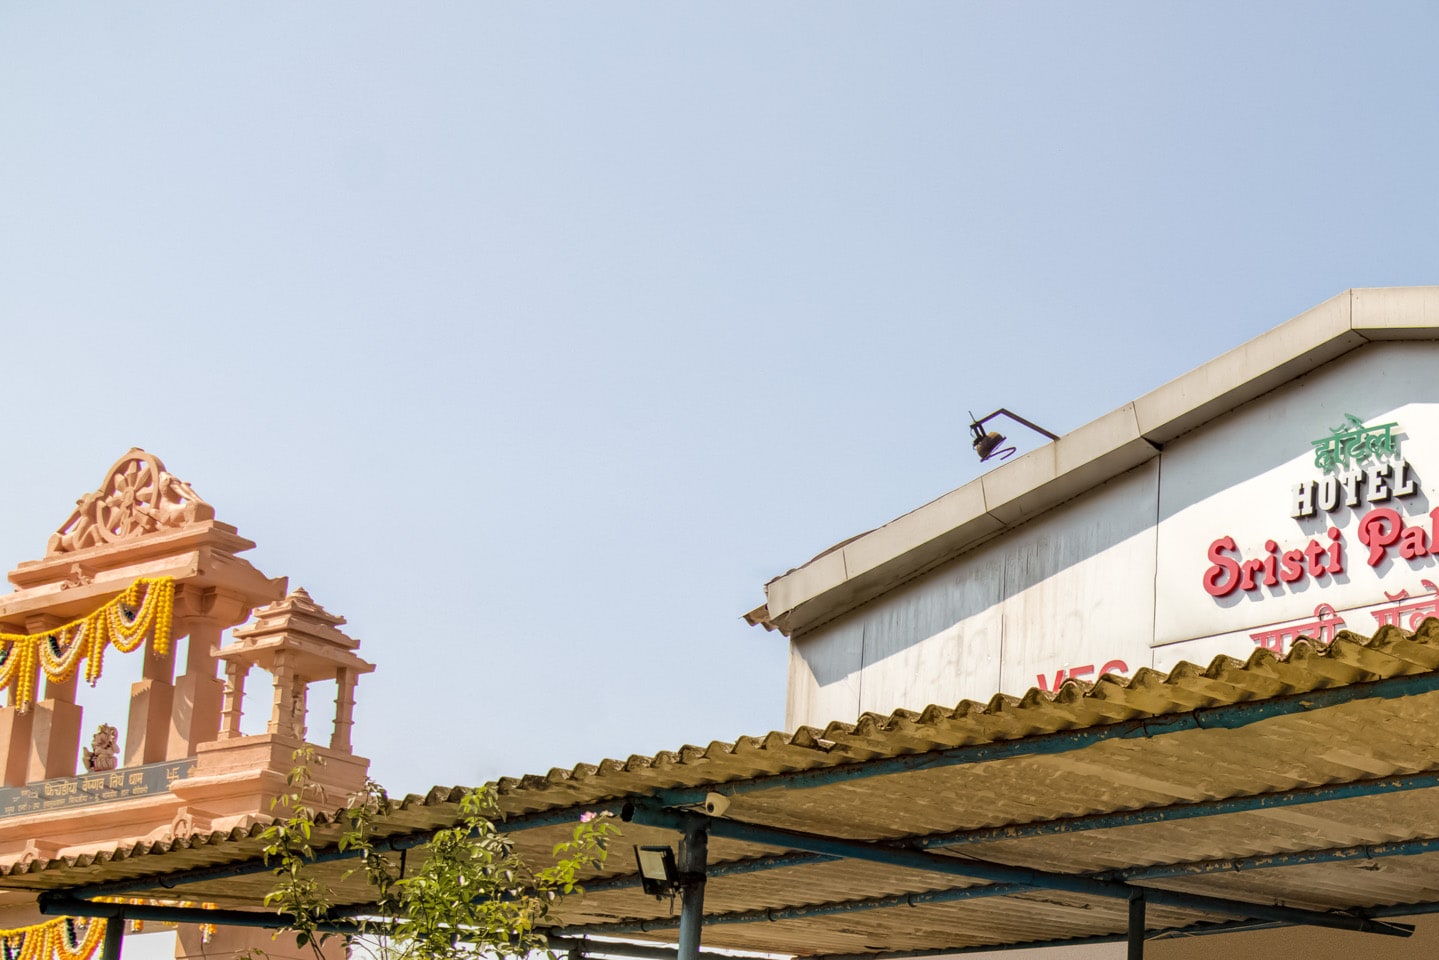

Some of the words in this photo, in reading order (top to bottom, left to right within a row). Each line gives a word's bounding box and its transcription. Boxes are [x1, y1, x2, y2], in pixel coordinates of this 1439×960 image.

[1311, 413, 1400, 471] हॉटेल
[1290, 459, 1418, 518] HOTEL
[1203, 526, 1343, 597] Sristi
